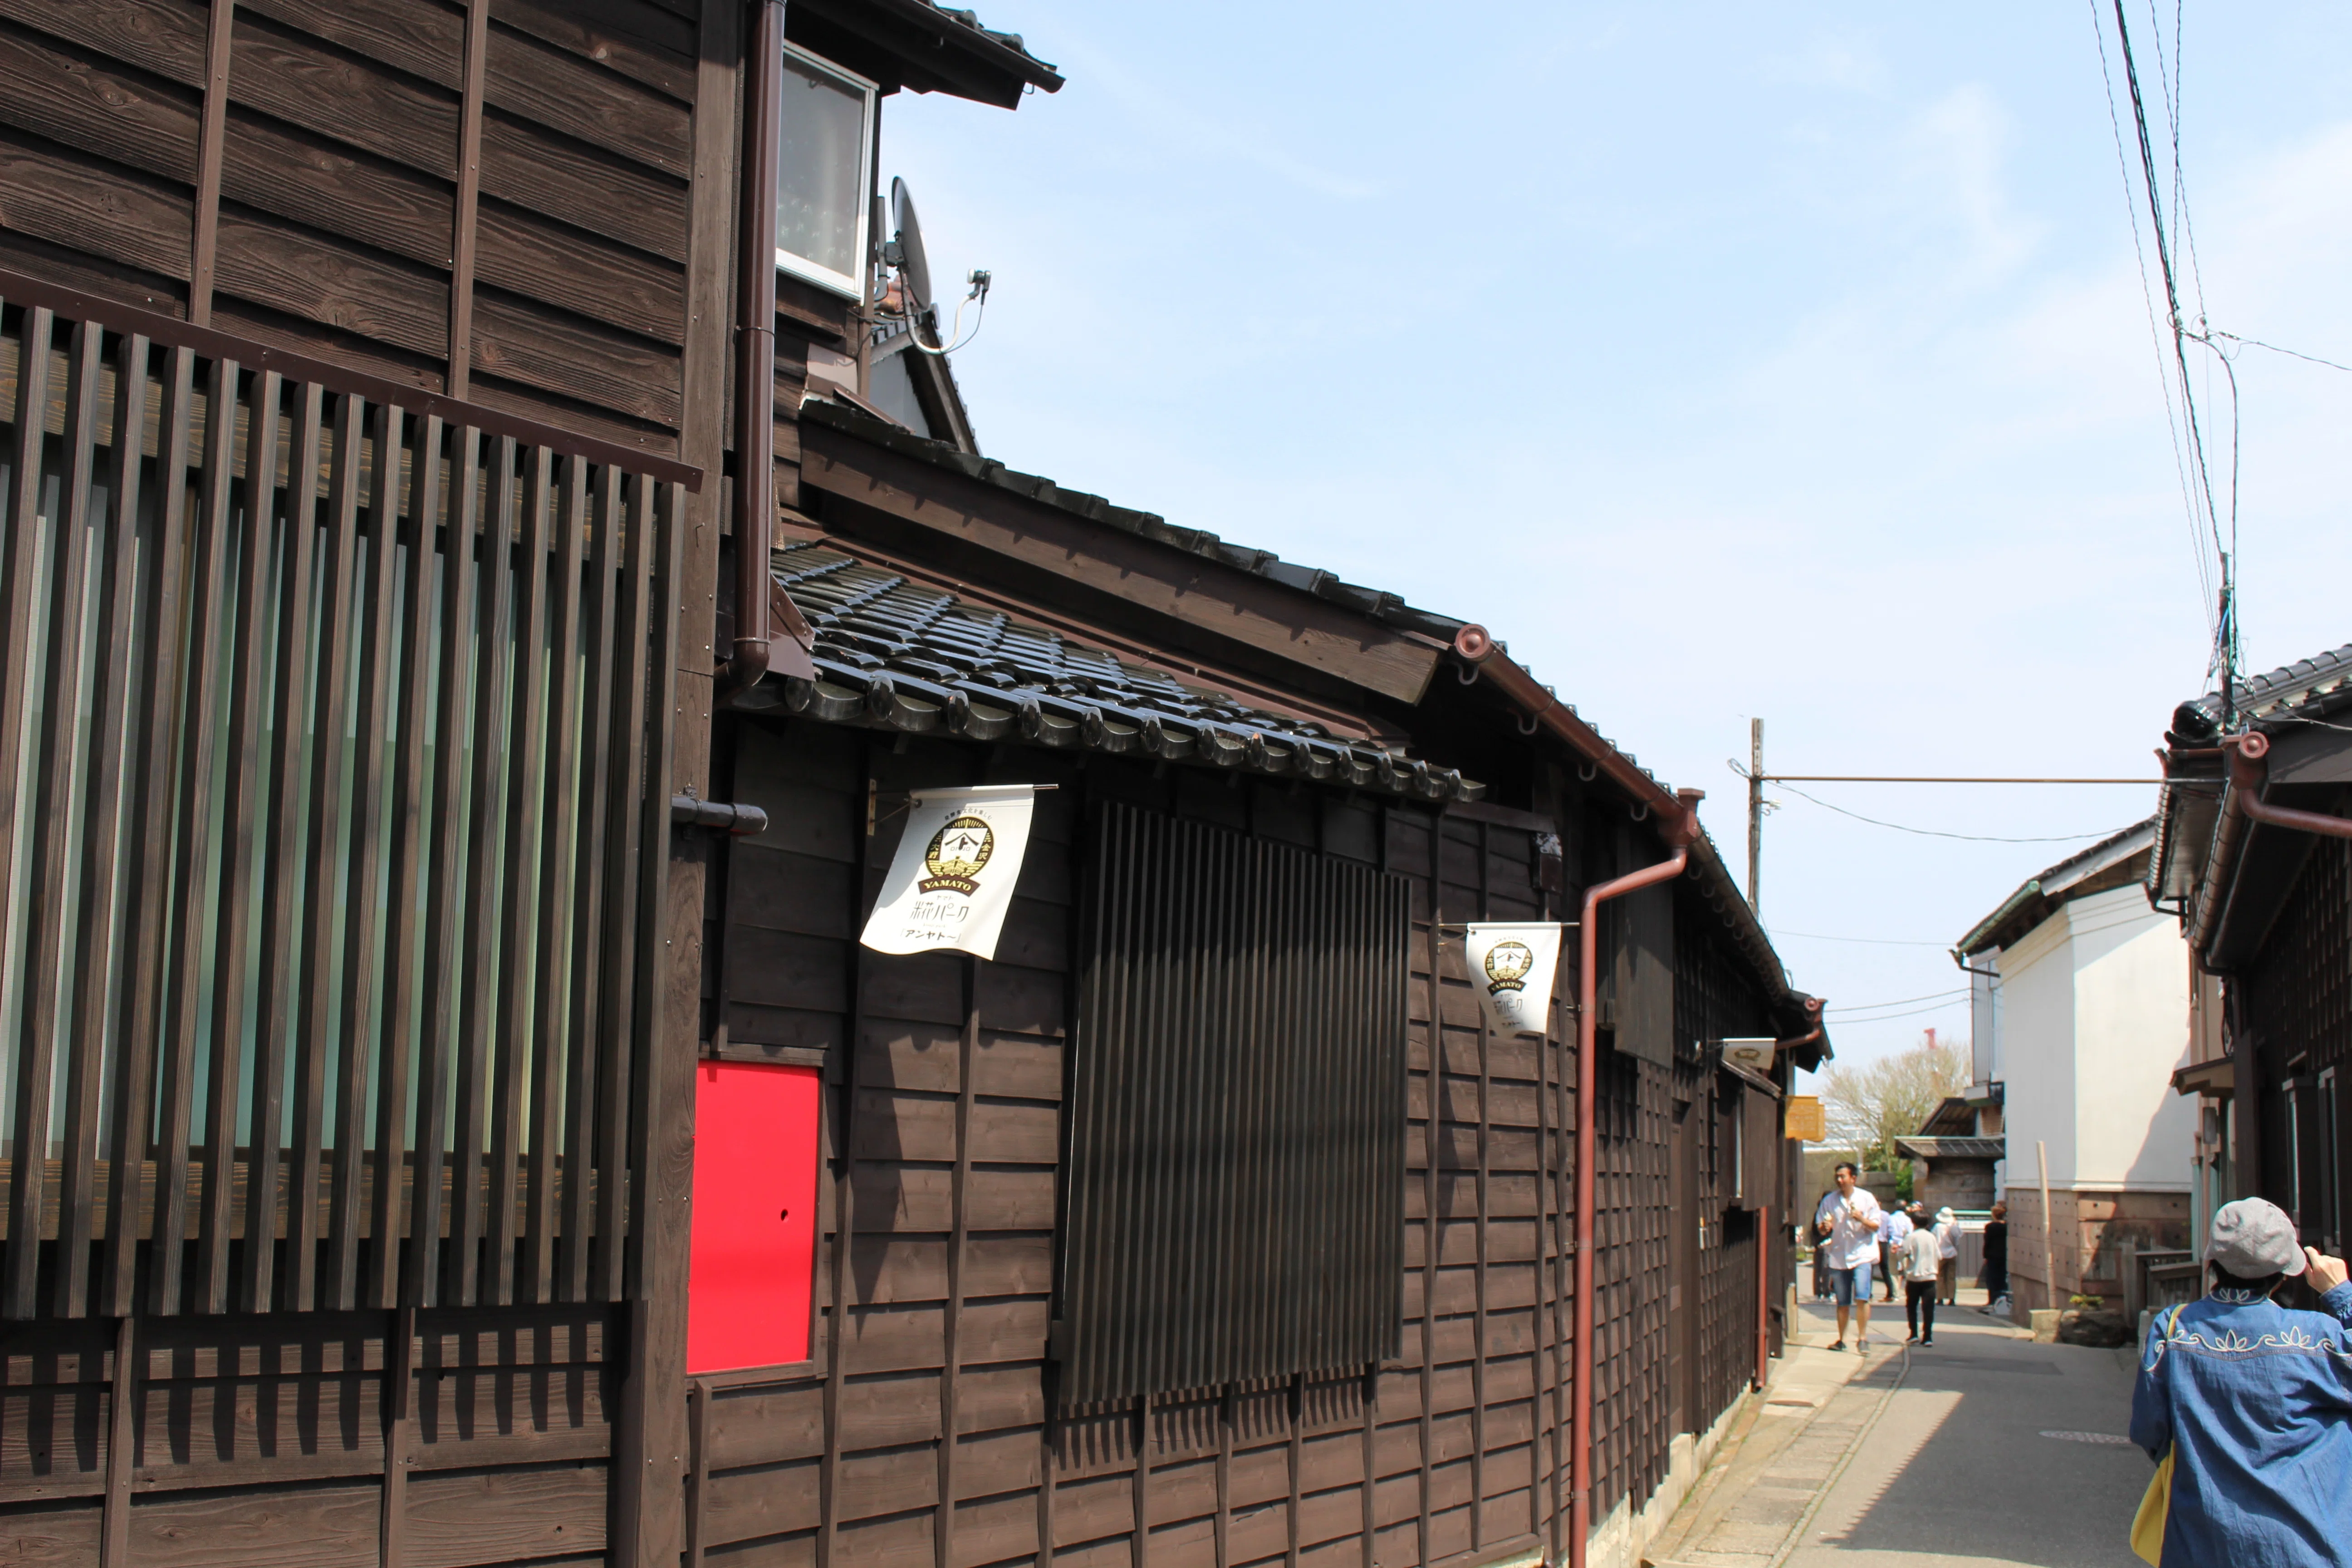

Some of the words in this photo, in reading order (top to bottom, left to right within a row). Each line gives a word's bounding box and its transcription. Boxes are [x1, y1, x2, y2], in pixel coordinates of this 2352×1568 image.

[928, 843, 940, 859] 大野
[978, 843, 991, 860] 金沢
[923, 879, 972, 892] YAMATO
[909, 901, 970, 923] 糀パーク
